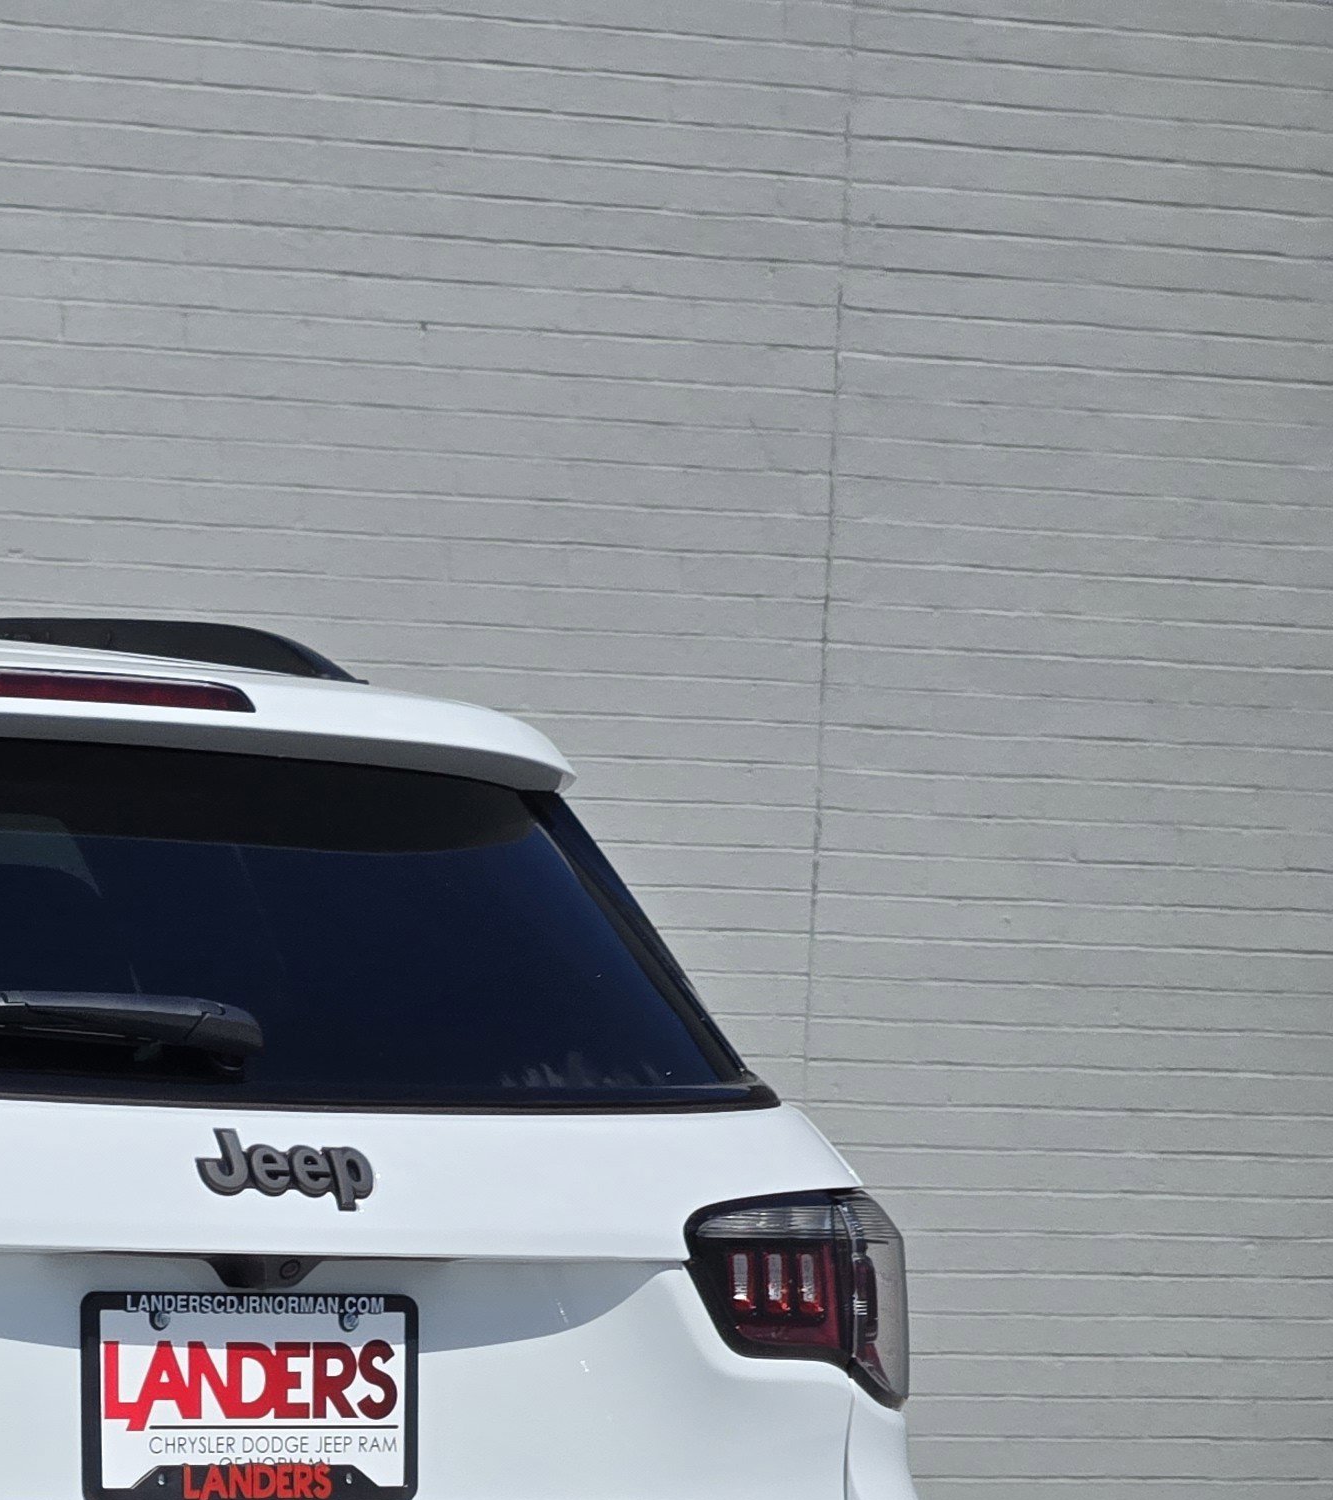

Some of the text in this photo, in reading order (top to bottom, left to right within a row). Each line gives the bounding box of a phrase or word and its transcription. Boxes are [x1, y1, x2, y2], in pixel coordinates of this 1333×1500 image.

[195, 1128, 374, 1211] Jeep
[126, 1294, 385, 1314] LANDERSCDJRNORMAN.COM
[102, 1339, 398, 1431] LANDERS
[148, 1436, 398, 1454] CHRYSLER DODGE JEEP RAM
